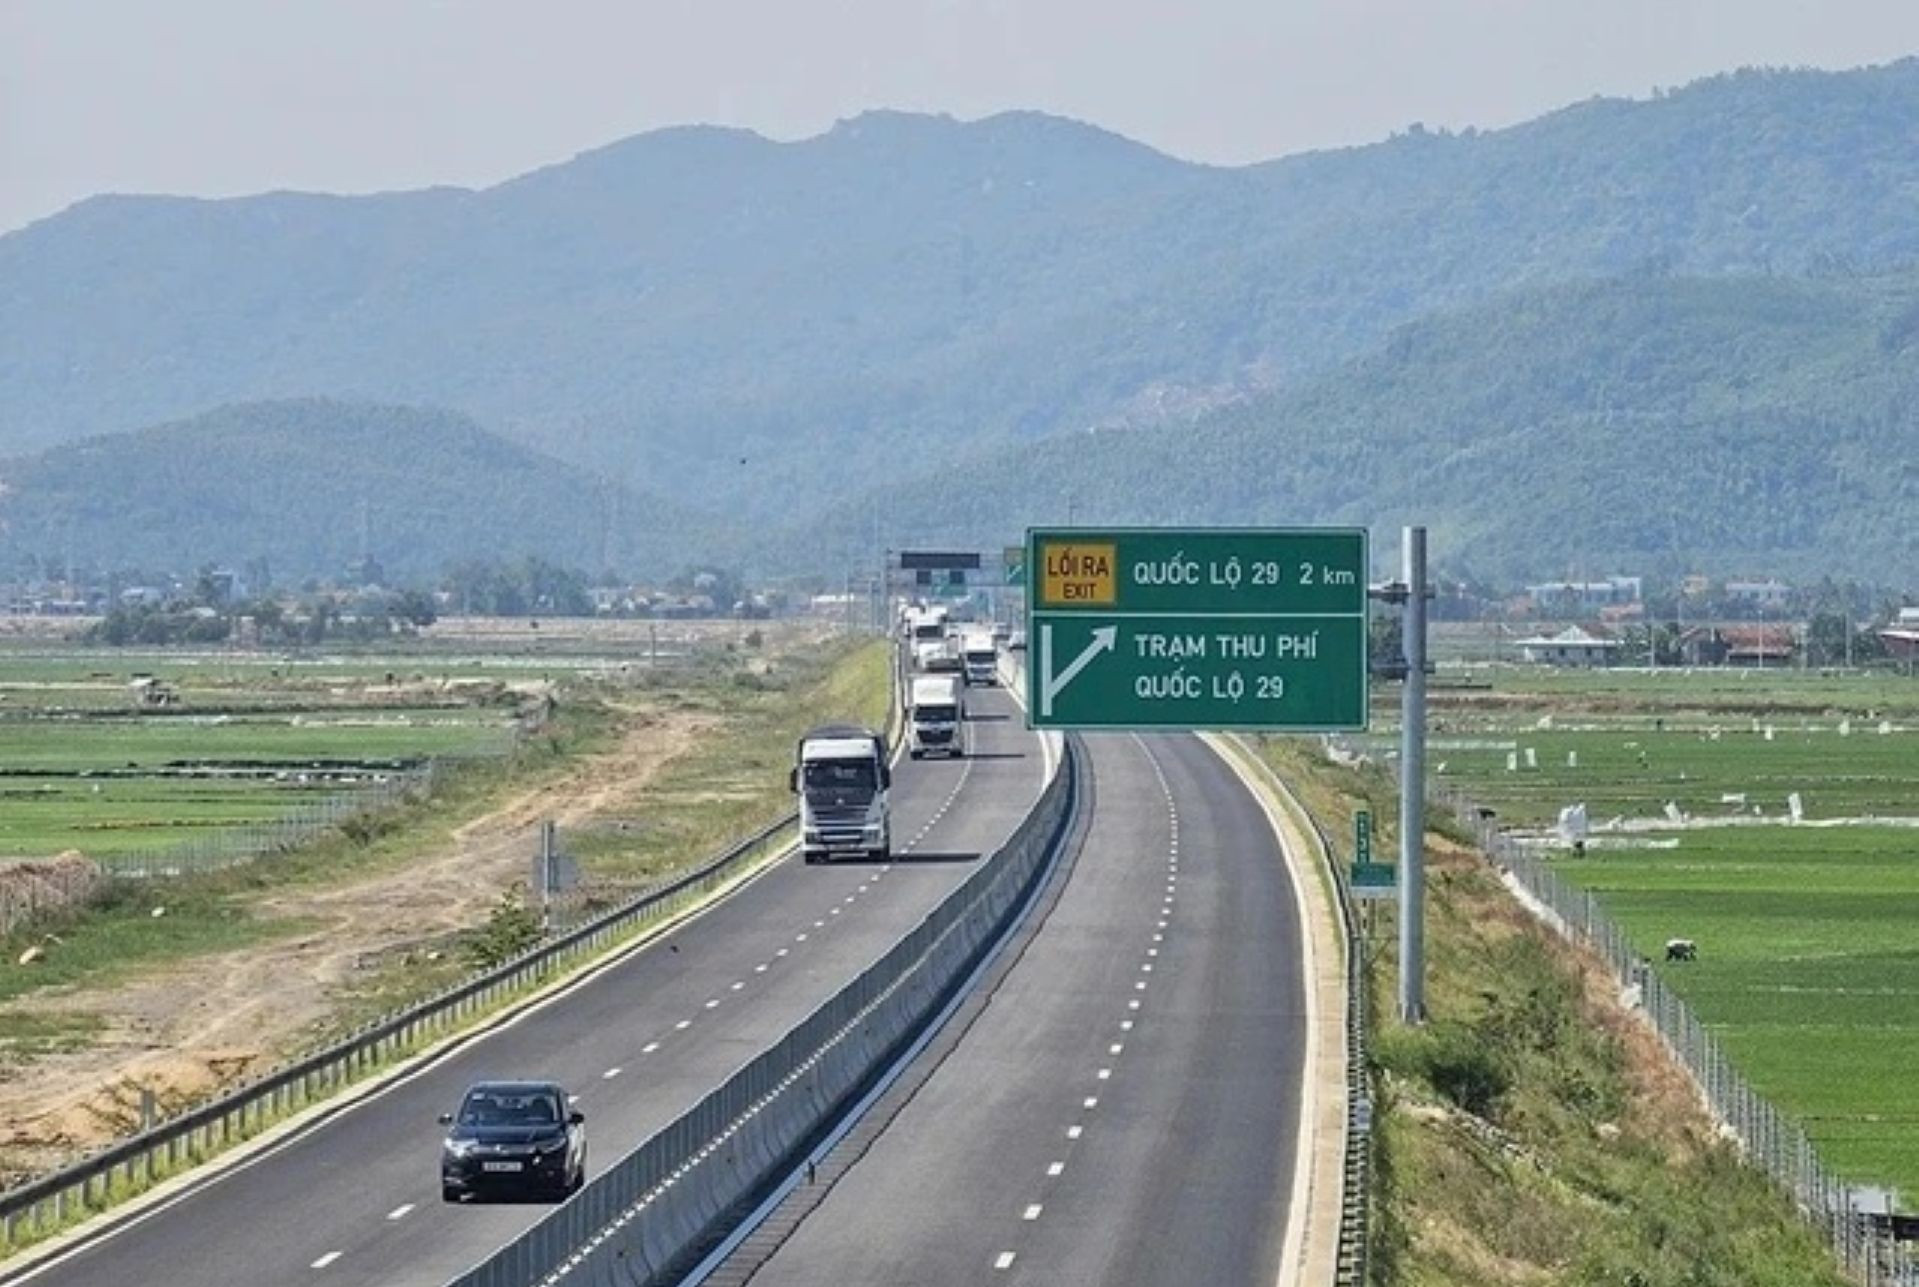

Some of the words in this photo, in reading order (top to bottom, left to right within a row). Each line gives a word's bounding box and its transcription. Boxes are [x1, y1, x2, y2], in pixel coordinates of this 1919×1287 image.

[1047, 547, 1078, 576] LỐI
[1082, 556, 1109, 577] RA
[1135, 550, 1199, 585] QUỐC
[1209, 556, 1242, 590] LỘ
[1251, 562, 1279, 585] 29
[1299, 562, 1313, 585] 2
[1323, 565, 1355, 585] km
[1063, 583, 1097, 599] EXIT
[1134, 634, 1206, 662] TRẠM
[1216, 634, 1265, 659] THU
[1278, 628, 1319, 659] PHÍ
[1135, 665, 1202, 699] QUỐC
[1212, 670, 1244, 704] LỘ
[1257, 675, 1283, 699] 29
